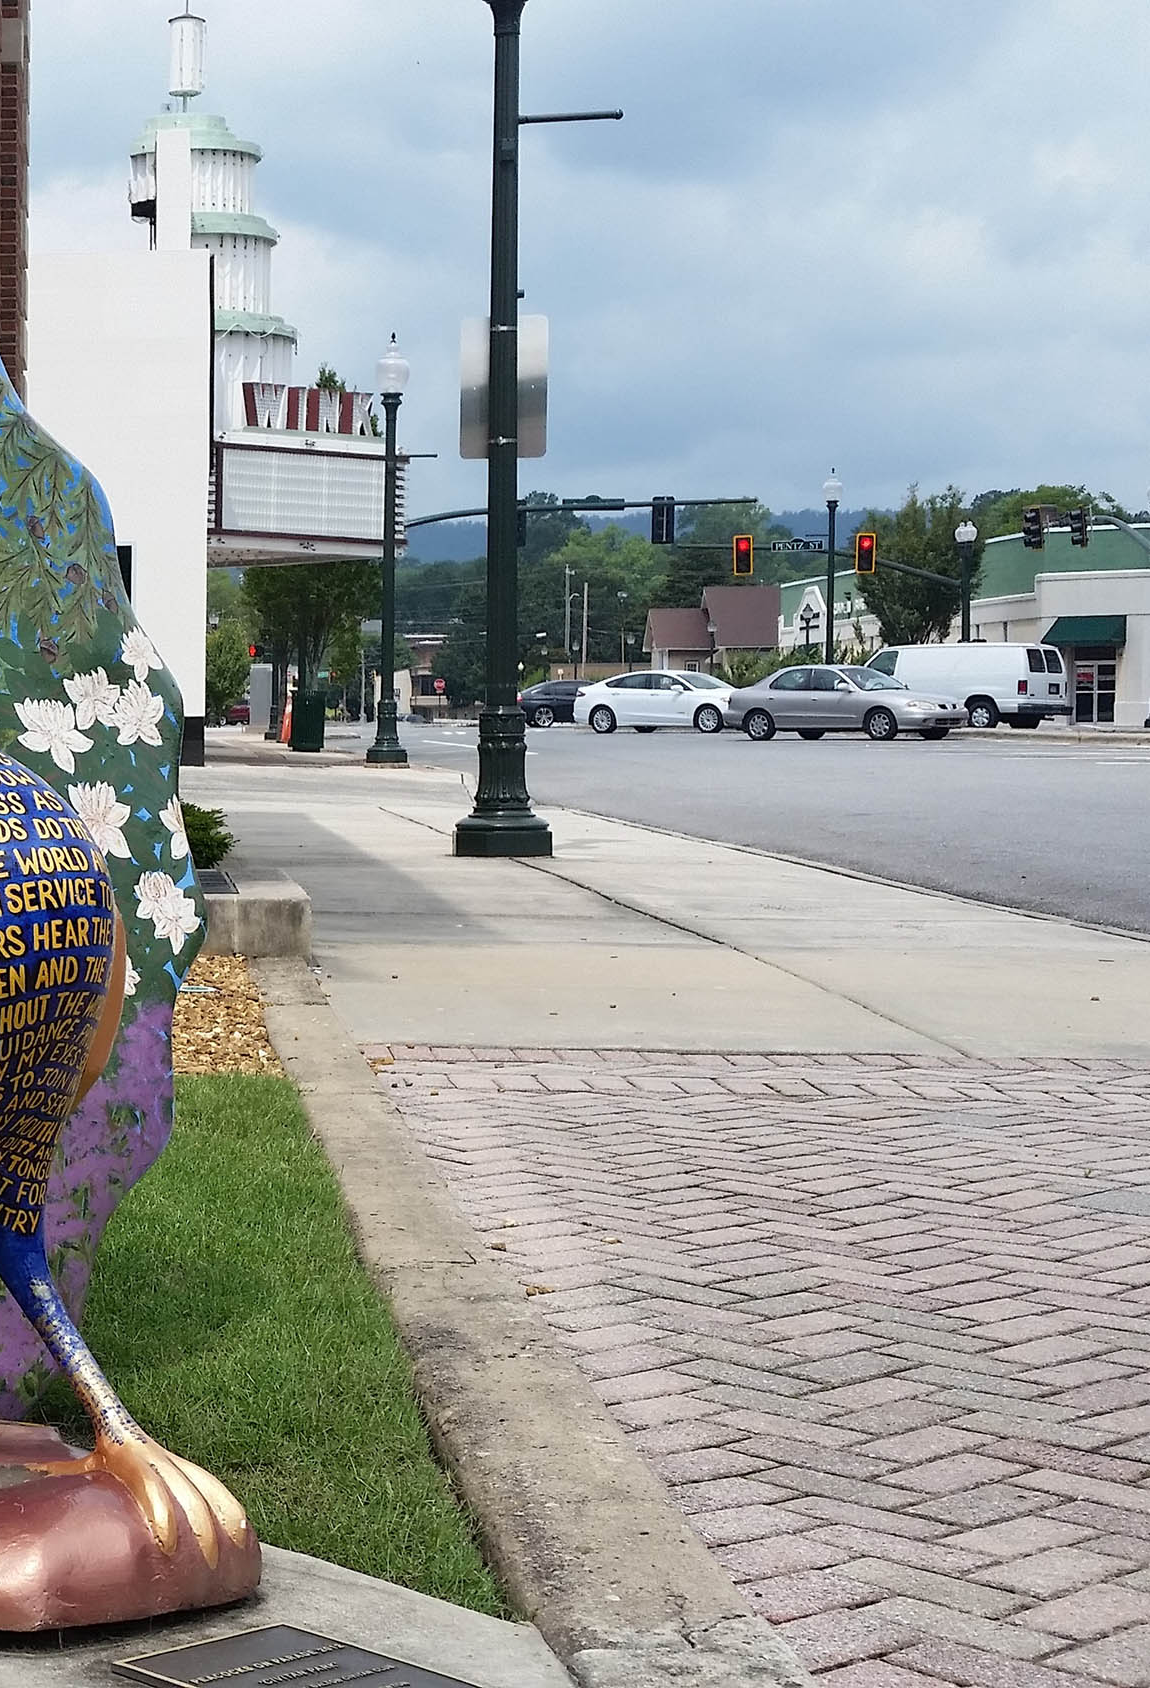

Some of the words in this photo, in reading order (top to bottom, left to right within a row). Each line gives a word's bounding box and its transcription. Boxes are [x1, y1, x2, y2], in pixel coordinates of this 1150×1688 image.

[242, 382, 374, 437] WINK
[775, 542, 804, 551] PENTZ
[809, 541, 821, 550] ST
[32, 790, 64, 812] AS
[32, 817, 64, 840] DO
[15, 846, 88, 876] WORLD
[7, 878, 97, 912] SERVICE
[99, 880, 112, 912] TO
[33, 918, 89, 951] HEAR
[92, 918, 111, 946] THE
[35, 956, 78, 990] AND
[84, 956, 107, 984] THE
[54, 991, 90, 1018] THE
[16, 1043, 50, 1074] MY
[50, 1043, 81, 1067] EYES
[10, 1071, 34, 1093] TO
[37, 1067, 69, 1090] JOIN
[4, 1090, 37, 1112] AND
[10, 1114, 58, 1144] MOUTH
[2, 1136, 37, 1155] DUTY
[8, 1154, 50, 1180] TONGU
[16, 1181, 47, 1206] FOR
[271, 1650, 318, 1663] PARADE
